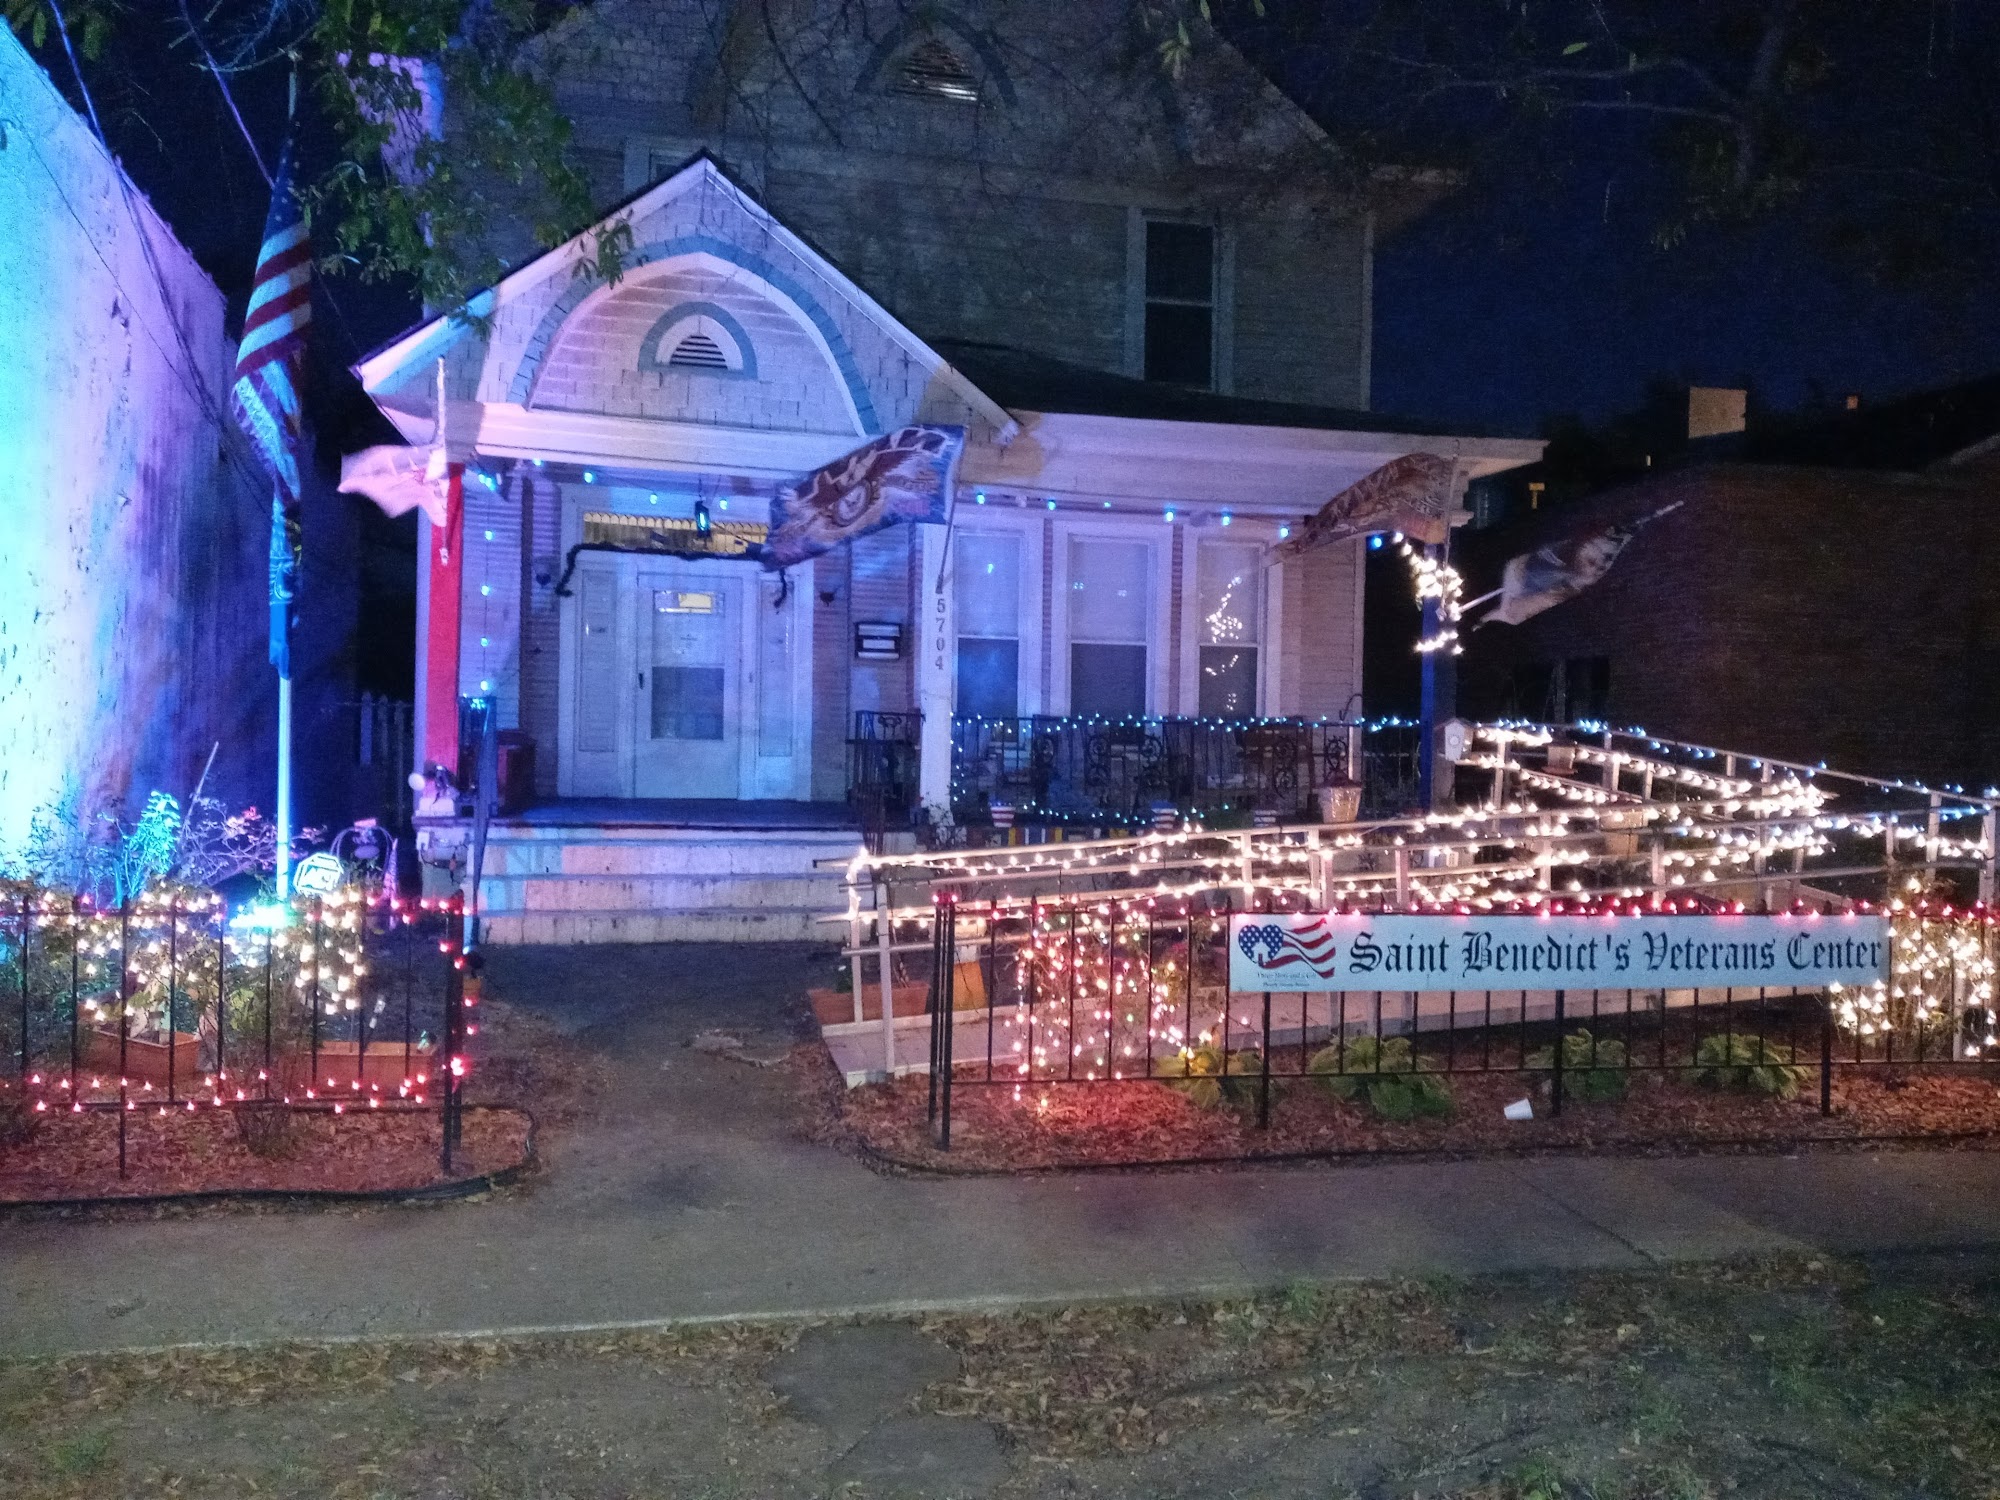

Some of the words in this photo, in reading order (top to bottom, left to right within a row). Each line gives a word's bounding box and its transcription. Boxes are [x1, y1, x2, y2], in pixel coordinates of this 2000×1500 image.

[935, 598, 946, 671] 5704
[1349, 931, 1450, 974] Saint
[1461, 931, 1631, 977] Benedict's
[1641, 930, 1776, 972] Veterans
[1787, 931, 1882, 971] Center
